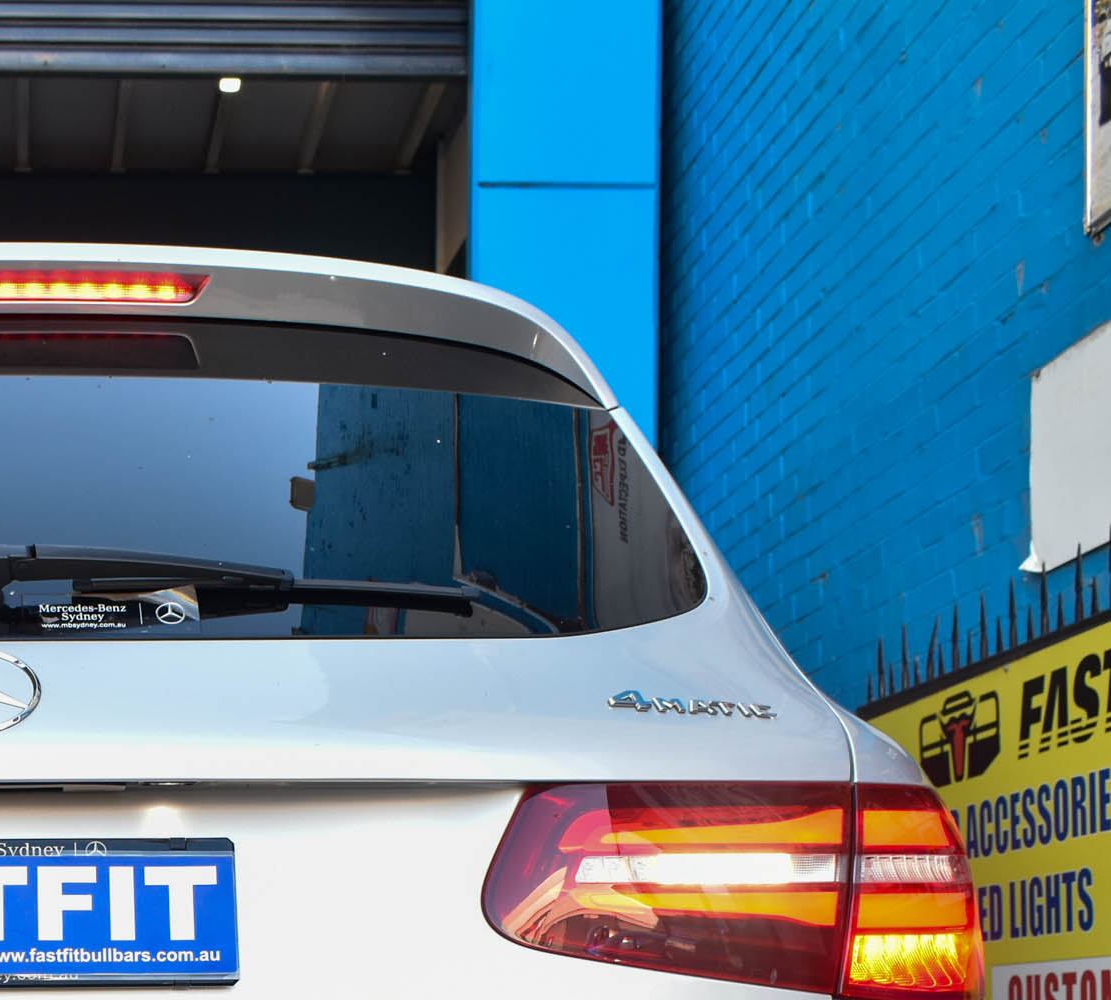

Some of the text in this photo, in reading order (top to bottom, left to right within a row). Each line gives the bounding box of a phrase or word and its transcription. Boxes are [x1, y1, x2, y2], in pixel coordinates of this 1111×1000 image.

[39, 604, 127, 613] Mercedes-Benz
[61, 612, 105, 622] Sydney
[607, 689, 778, 720] 4MATIC
[1018, 649, 1111, 760] FAS
[966, 767, 1111, 860] ACCESSORIE
[978, 867, 1095, 942] ED LIGHTS
